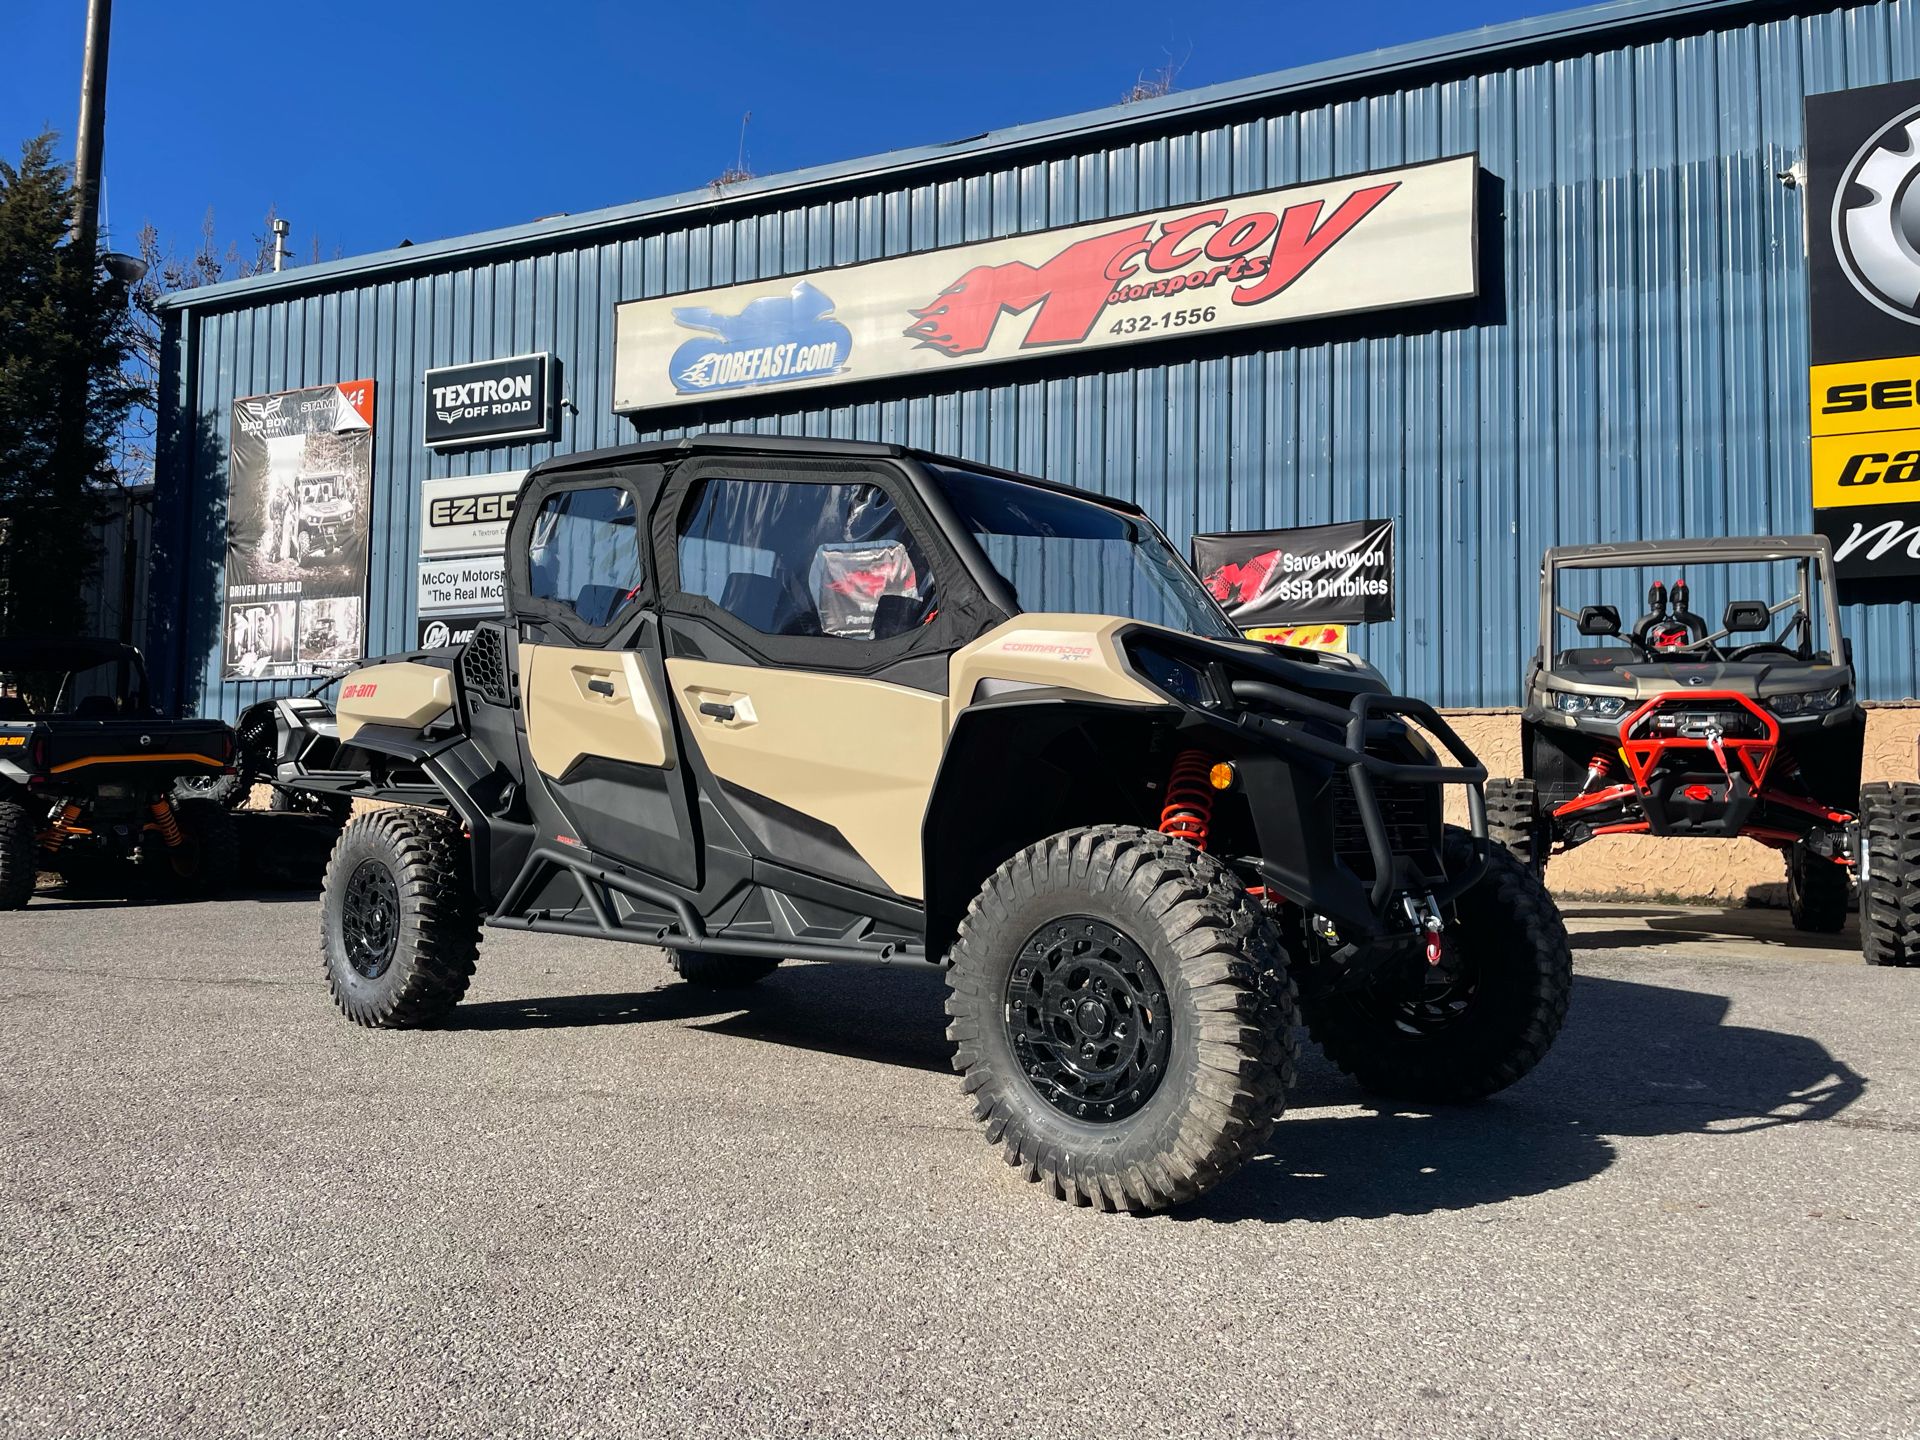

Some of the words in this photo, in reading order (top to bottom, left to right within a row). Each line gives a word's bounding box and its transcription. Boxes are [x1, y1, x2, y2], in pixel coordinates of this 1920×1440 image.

[1109, 306, 1217, 337] 432-1556
[690, 342, 838, 388] TOBEFAST.com
[432, 374, 532, 409] TEXTRON
[1821, 379, 1920, 415] SE
[464, 406, 489, 418] OFF
[492, 400, 532, 415] ROAD
[241, 420, 263, 432] BAD
[266, 416, 289, 428] BOY
[478, 529, 499, 537] Textron
[1283, 552, 1321, 573] Save
[1325, 550, 1360, 569] Now
[1363, 550, 1384, 567] on
[422, 572, 459, 586] McCoy
[230, 584, 256, 597] DRIVEN
[258, 583, 268, 595] BY
[269, 582, 283, 594] THE
[284, 581, 302, 593] BOLD
[427, 589, 451, 602] "The
[454, 587, 478, 600] Real
[1280, 579, 1313, 601] SSR
[1317, 576, 1389, 599] Dirtbikes
[1002, 643, 1092, 655] COMMANDER
[342, 684, 377, 699] can-am
